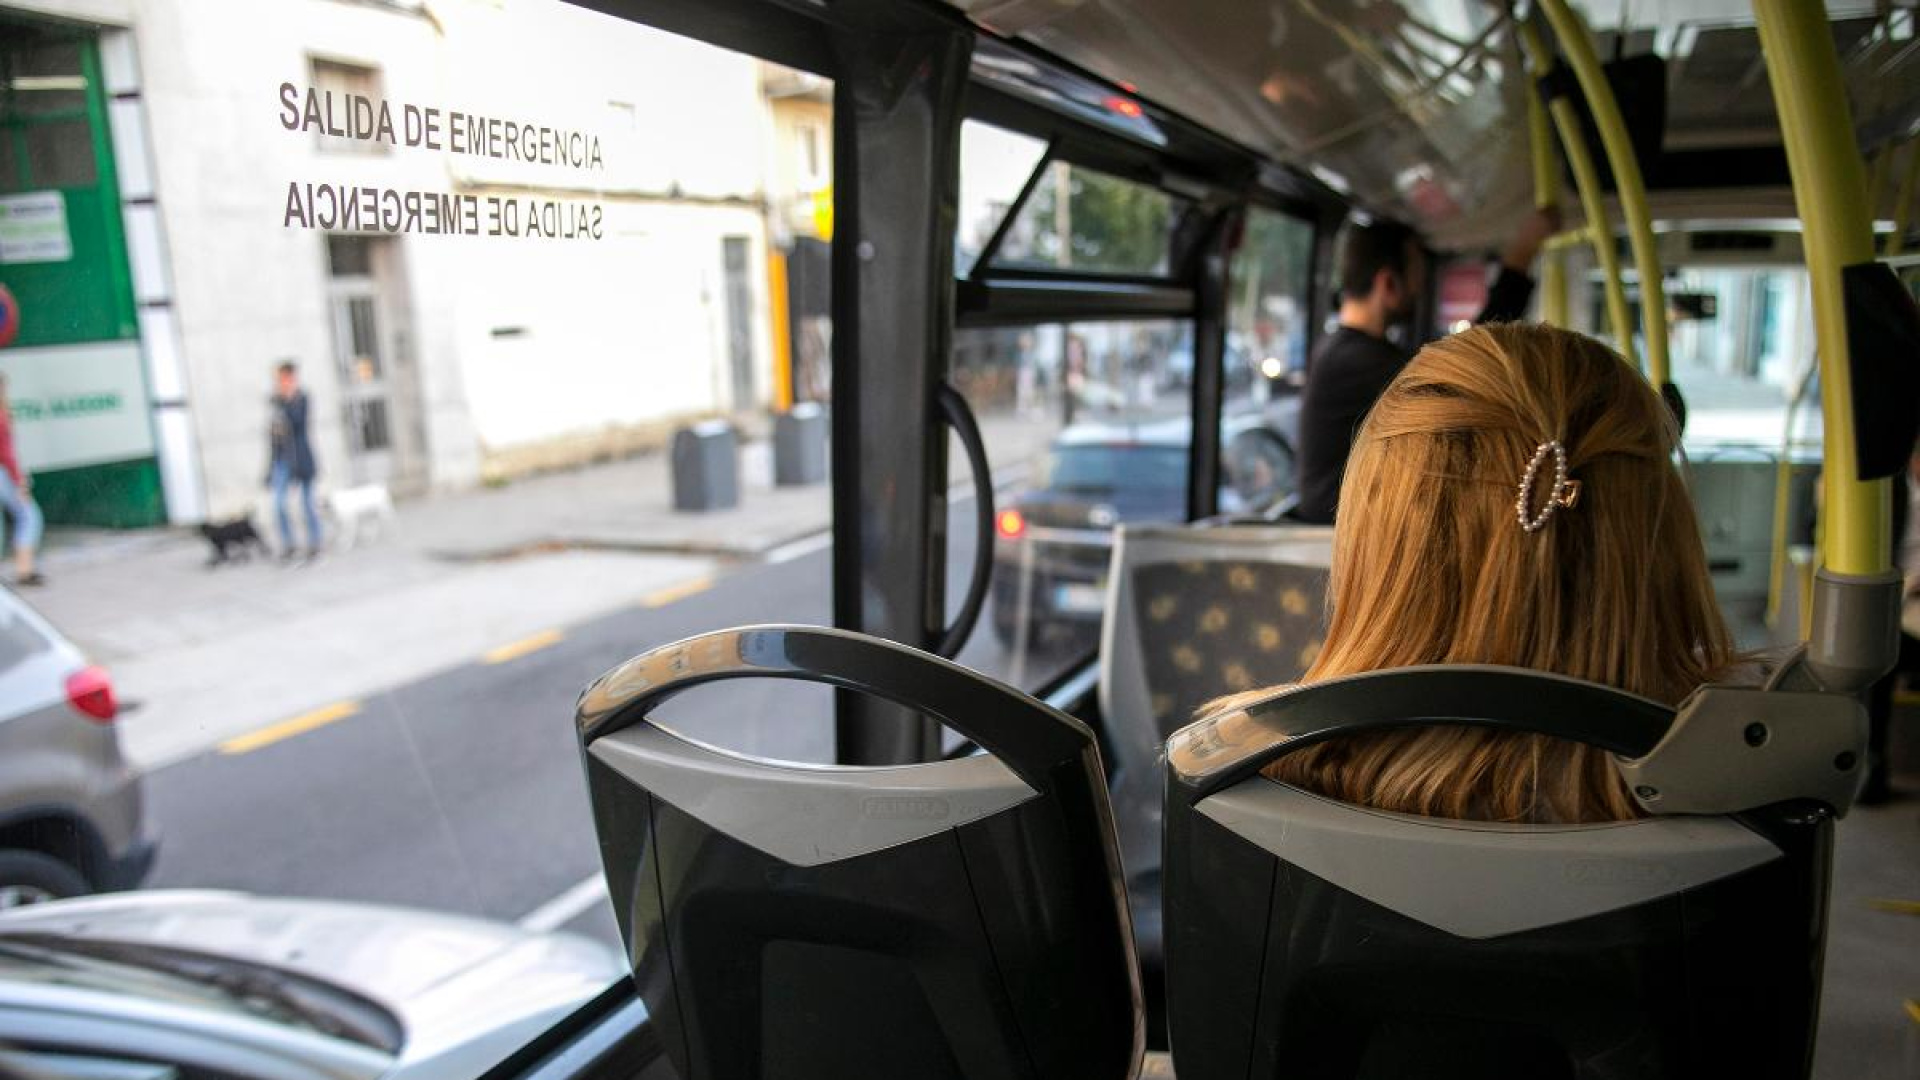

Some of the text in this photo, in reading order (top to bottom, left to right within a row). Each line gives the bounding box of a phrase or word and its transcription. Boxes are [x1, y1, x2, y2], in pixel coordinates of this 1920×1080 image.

[279, 82, 604, 170] SALIDA DE EMERGENCIA
